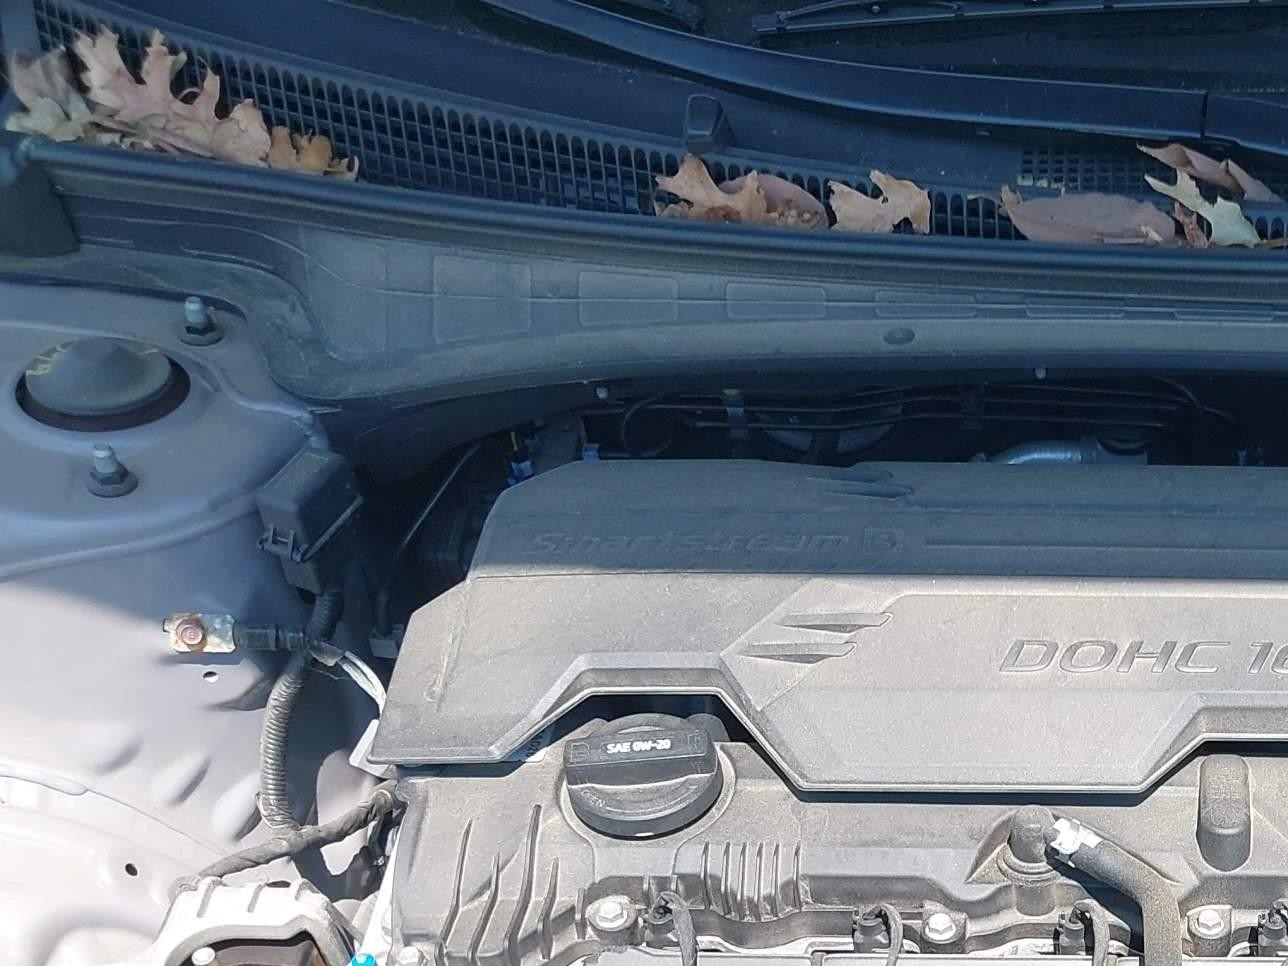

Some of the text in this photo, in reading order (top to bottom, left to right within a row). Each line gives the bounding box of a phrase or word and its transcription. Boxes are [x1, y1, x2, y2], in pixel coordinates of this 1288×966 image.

[999, 640, 1230, 673] DOHC
[606, 739, 671, 754] SAE 0W-20
